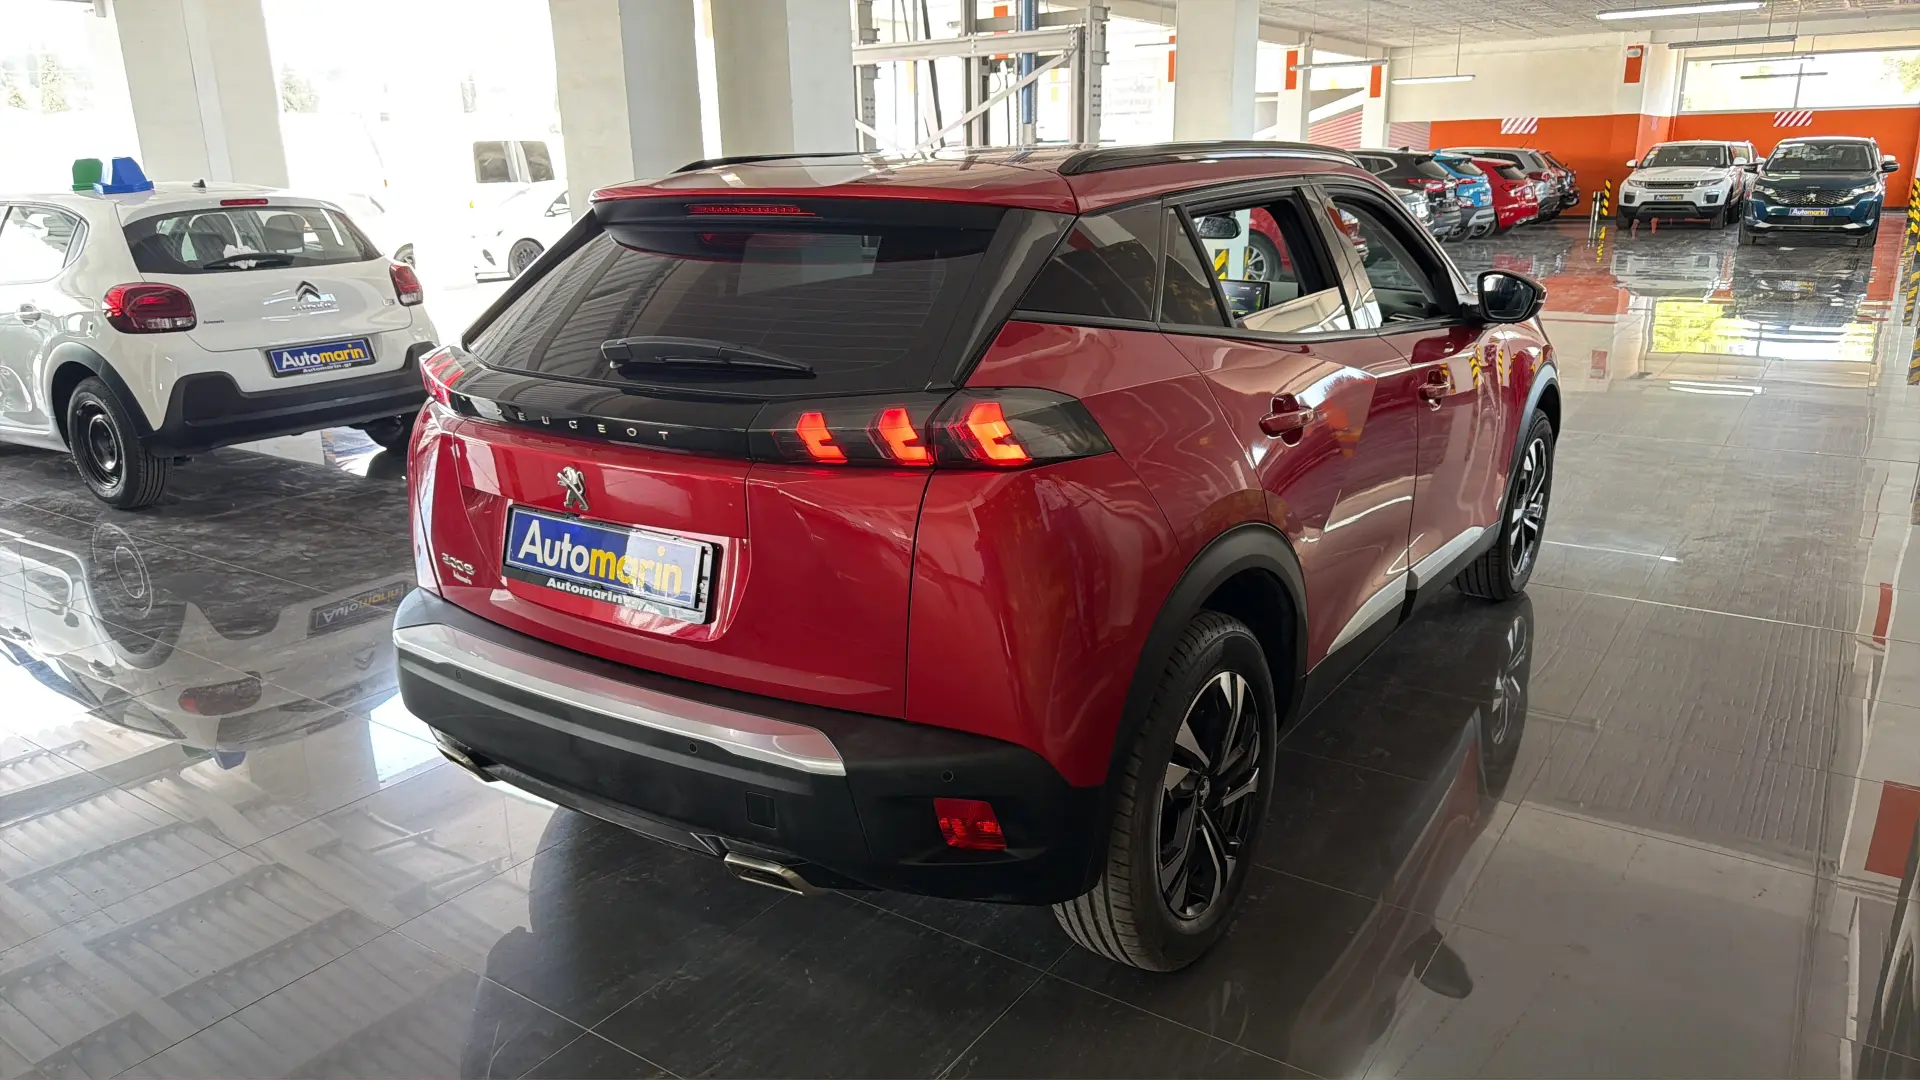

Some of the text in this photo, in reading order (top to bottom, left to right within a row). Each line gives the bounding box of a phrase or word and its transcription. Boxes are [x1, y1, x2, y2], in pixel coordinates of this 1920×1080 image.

[1791, 207, 1827, 216] Automarin
[281, 343, 365, 370] Automarin
[302, 362, 353, 374] Automarin.gr
[517, 520, 683, 595] Automarin
